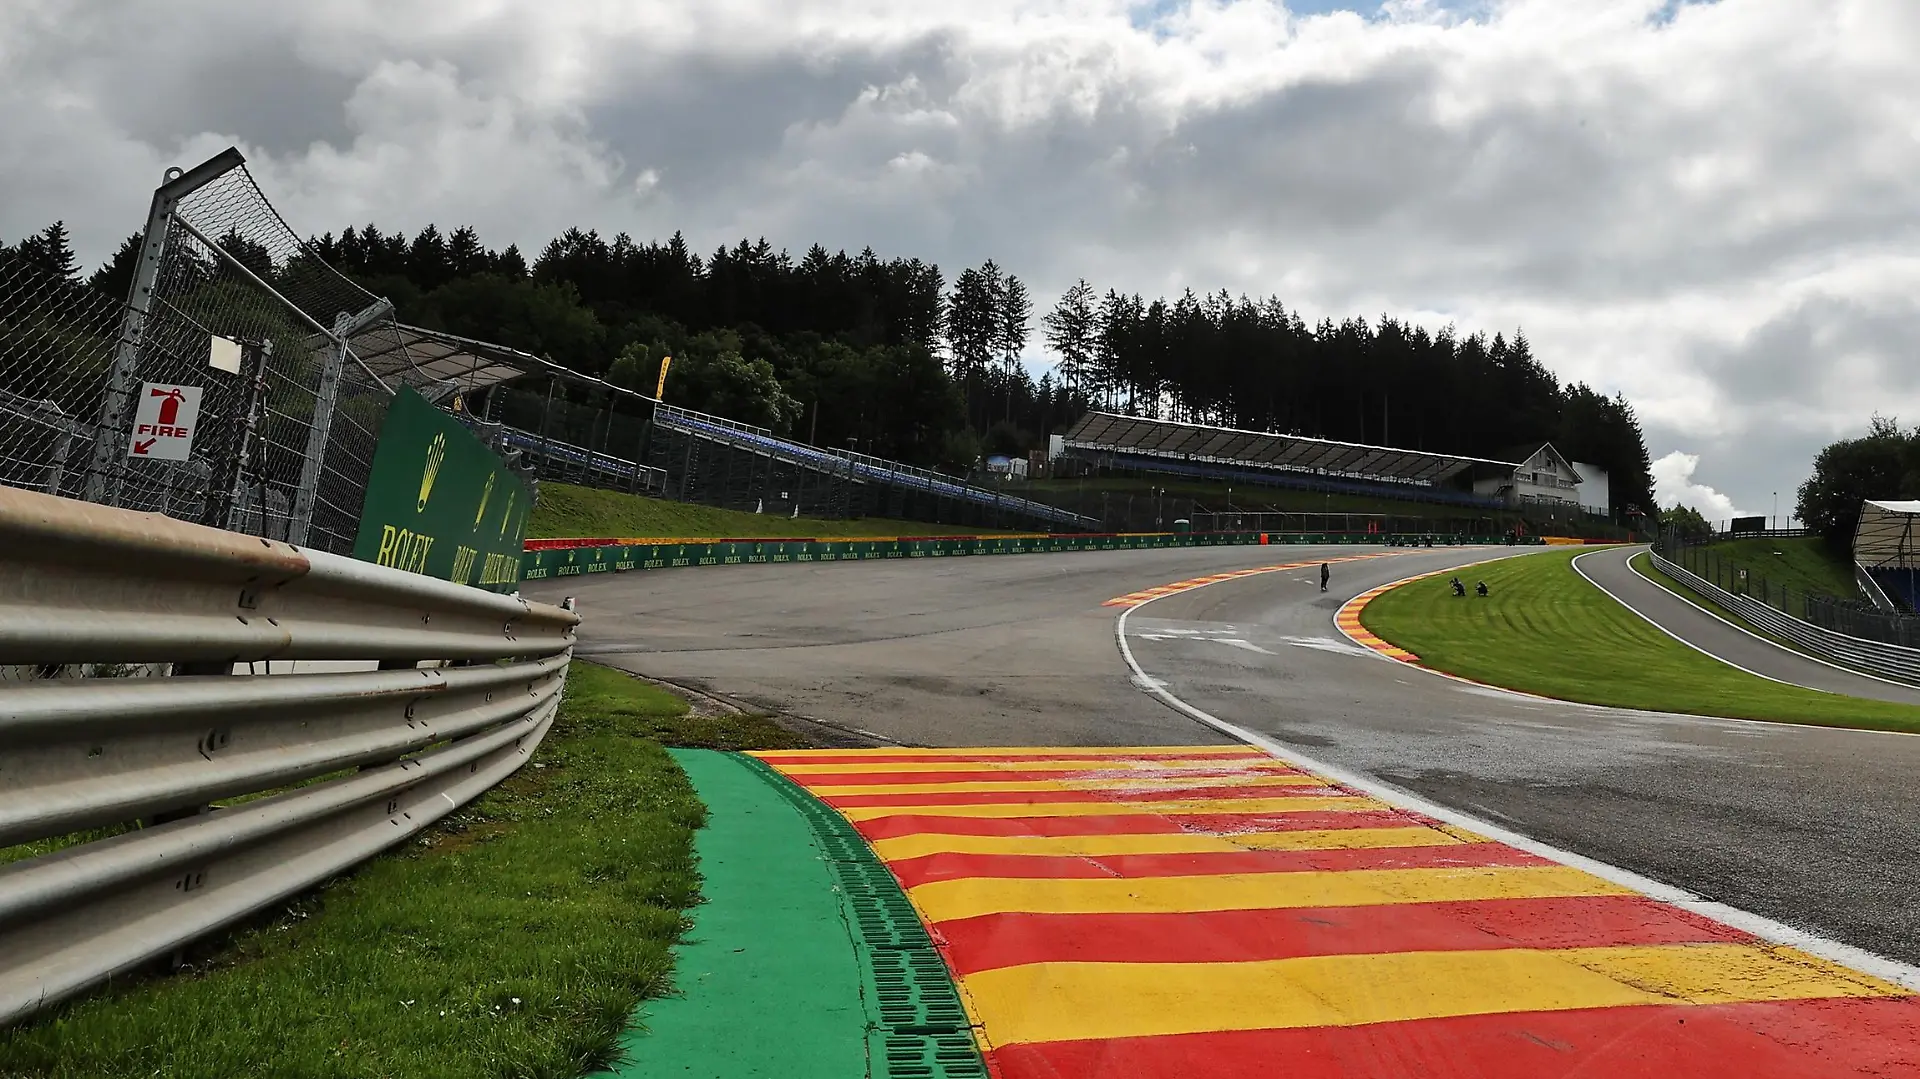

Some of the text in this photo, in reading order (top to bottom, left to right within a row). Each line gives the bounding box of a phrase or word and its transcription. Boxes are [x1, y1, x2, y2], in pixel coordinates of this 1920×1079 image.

[138, 424, 188, 438] FIRE
[376, 524, 435, 575] ROLEX
[643, 558, 664, 568] ROLEX
[672, 557, 690, 567] ROLEX
[698, 556, 717, 565] ROLEX
[724, 555, 741, 564] ROLEX
[748, 554, 767, 563] ROLEX
[587, 562, 607, 573] ROLEX
[615, 560, 635, 570] ROLEX
[526, 568, 547, 579] ROLEX
[557, 565, 580, 576] ROLEX
